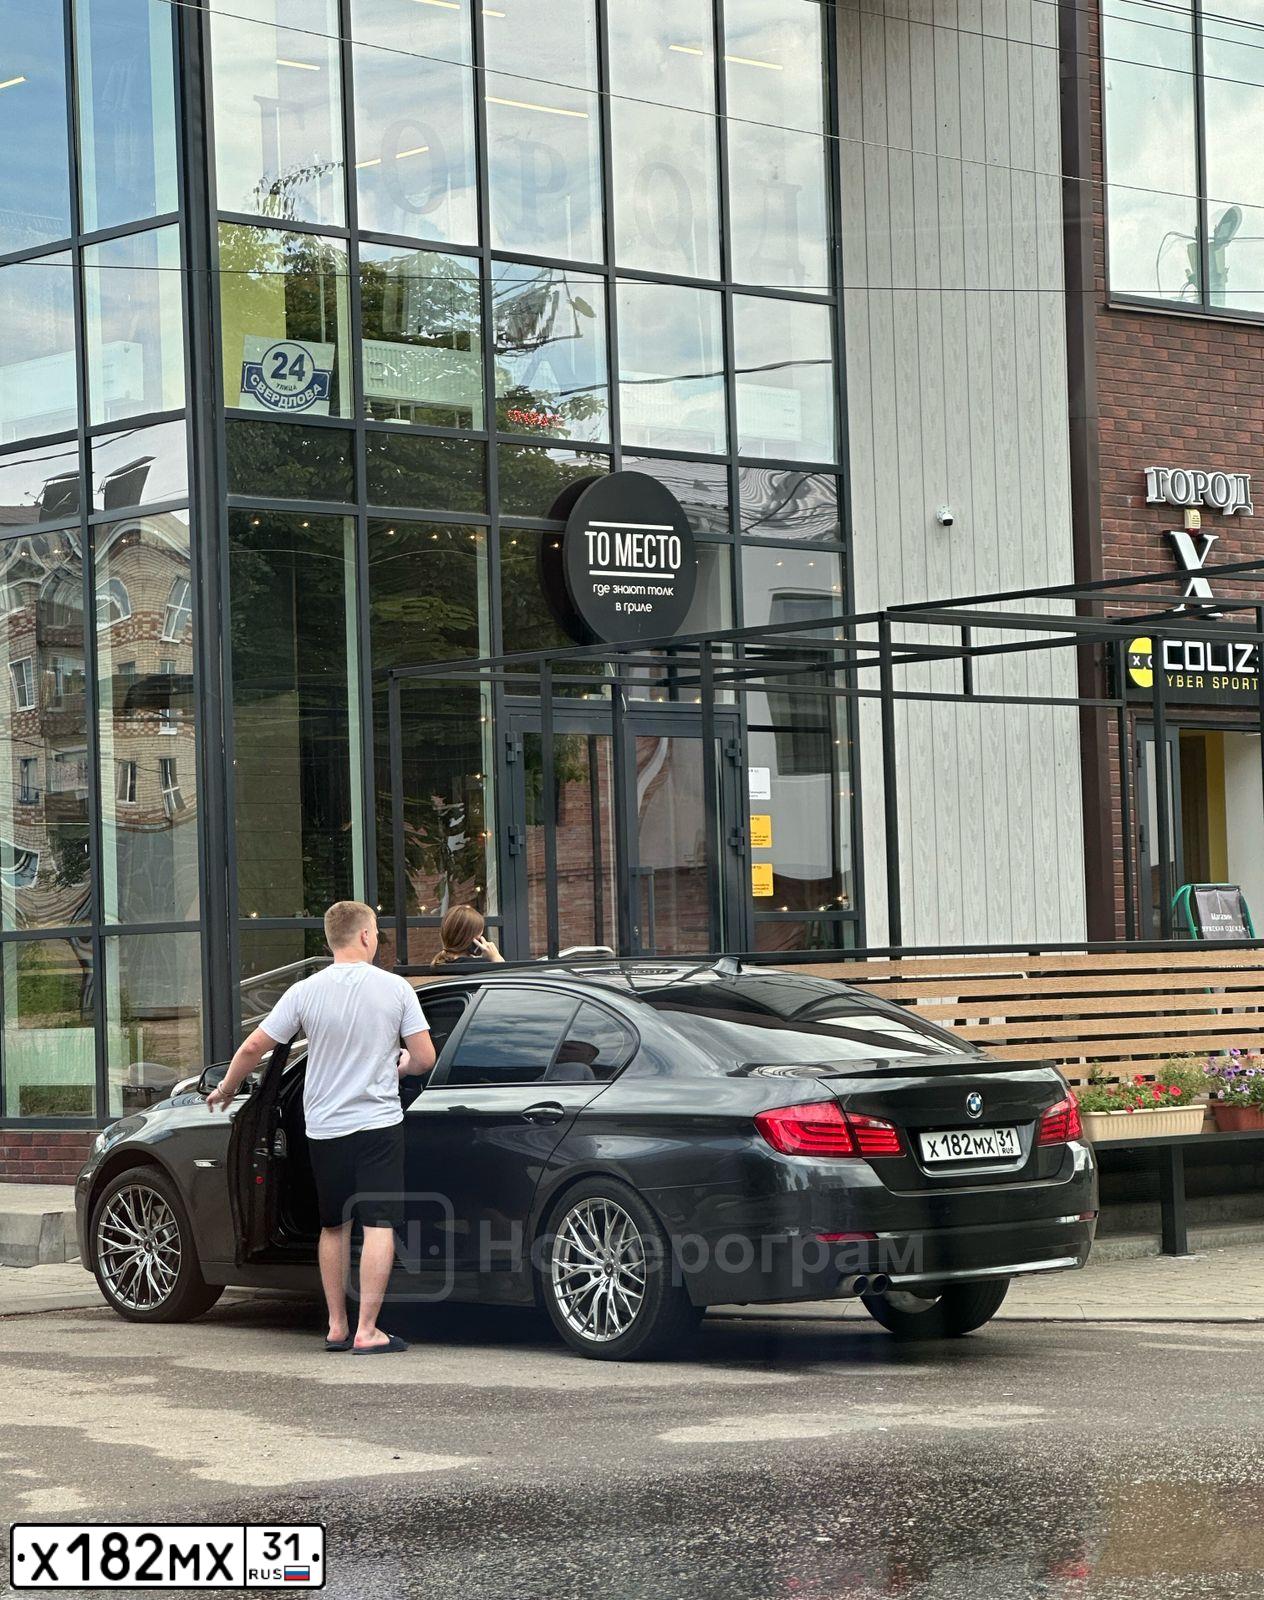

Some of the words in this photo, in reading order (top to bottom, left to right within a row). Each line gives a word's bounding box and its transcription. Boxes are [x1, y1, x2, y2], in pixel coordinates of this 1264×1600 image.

[271, 351, 305, 382] 24
[250, 374, 322, 409] СВЕРДЛОВА
[275, 382, 297, 392] УЛИЦА
[1144, 466, 1253, 516] ГОРОД
[584, 531, 610, 566] ТО
[615, 532, 681, 570] МЕСТО
[592, 583, 611, 597] где
[612, 584, 646, 596] знают
[647, 586, 674, 597] толк
[615, 602, 622, 612] в
[623, 602, 653, 614] гриле
[1163, 640, 1259, 673] COLIZ
[1166, 674, 1204, 689] YBER
[1212, 676, 1259, 690] SPORT
